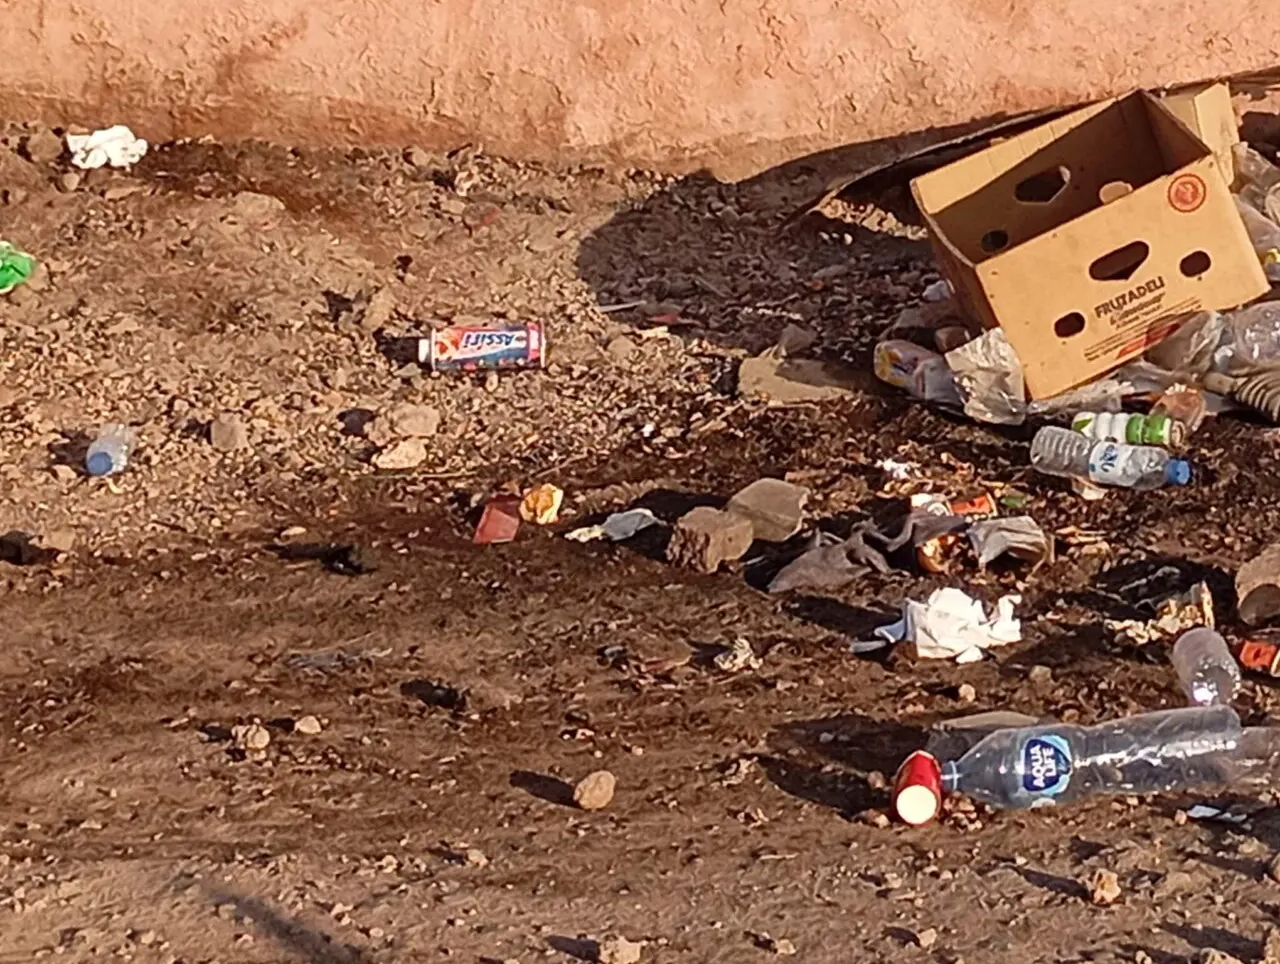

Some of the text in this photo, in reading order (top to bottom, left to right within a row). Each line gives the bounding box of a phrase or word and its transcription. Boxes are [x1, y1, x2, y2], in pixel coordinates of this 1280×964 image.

[1094, 276, 1165, 318] FRUTADELI
[1029, 744, 1046, 788] AQUA
[1042, 747, 1057, 777] LIFE
